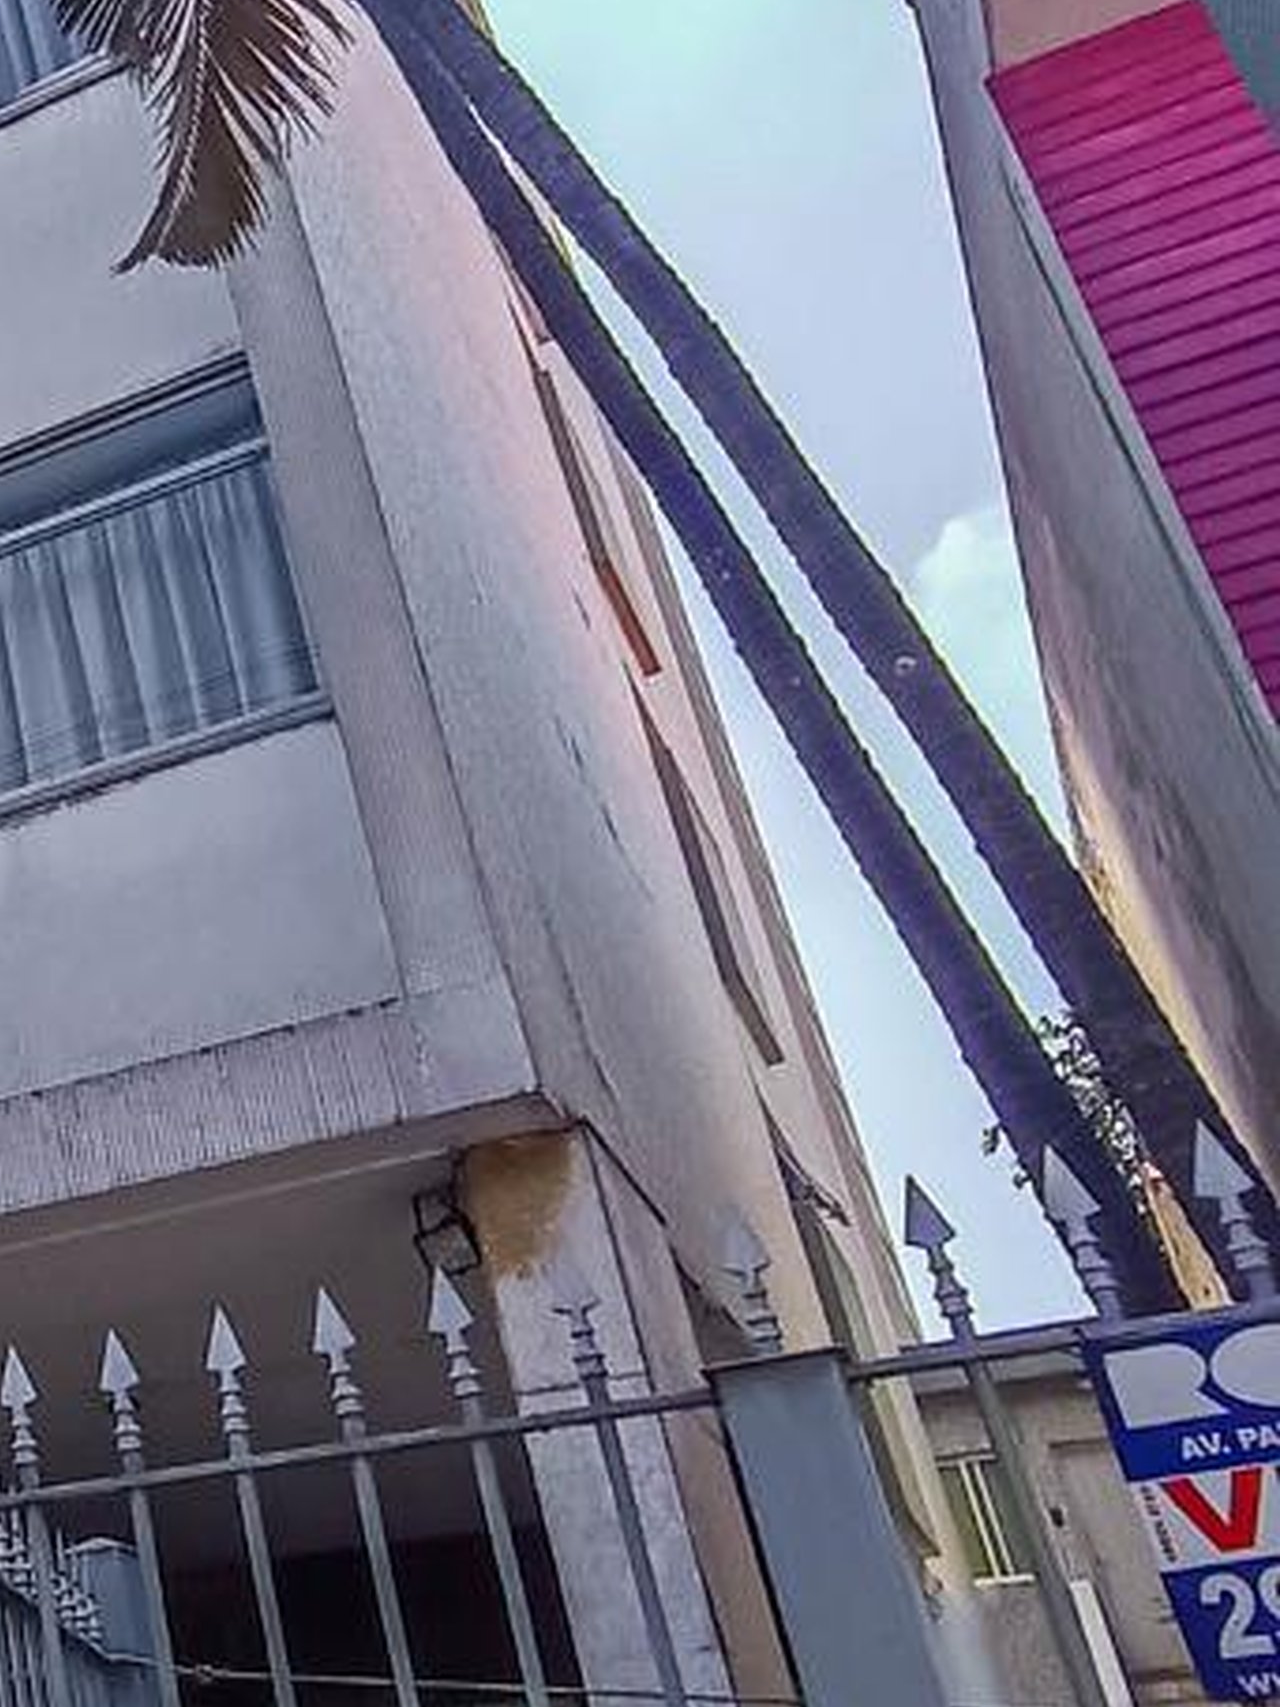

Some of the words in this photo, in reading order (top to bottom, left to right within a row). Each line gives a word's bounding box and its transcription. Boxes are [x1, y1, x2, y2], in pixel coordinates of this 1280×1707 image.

[1182, 1432, 1232, 1461] AV.
[1236, 1421, 1280, 1451] PA
[1158, 1468, 1280, 1554] V
